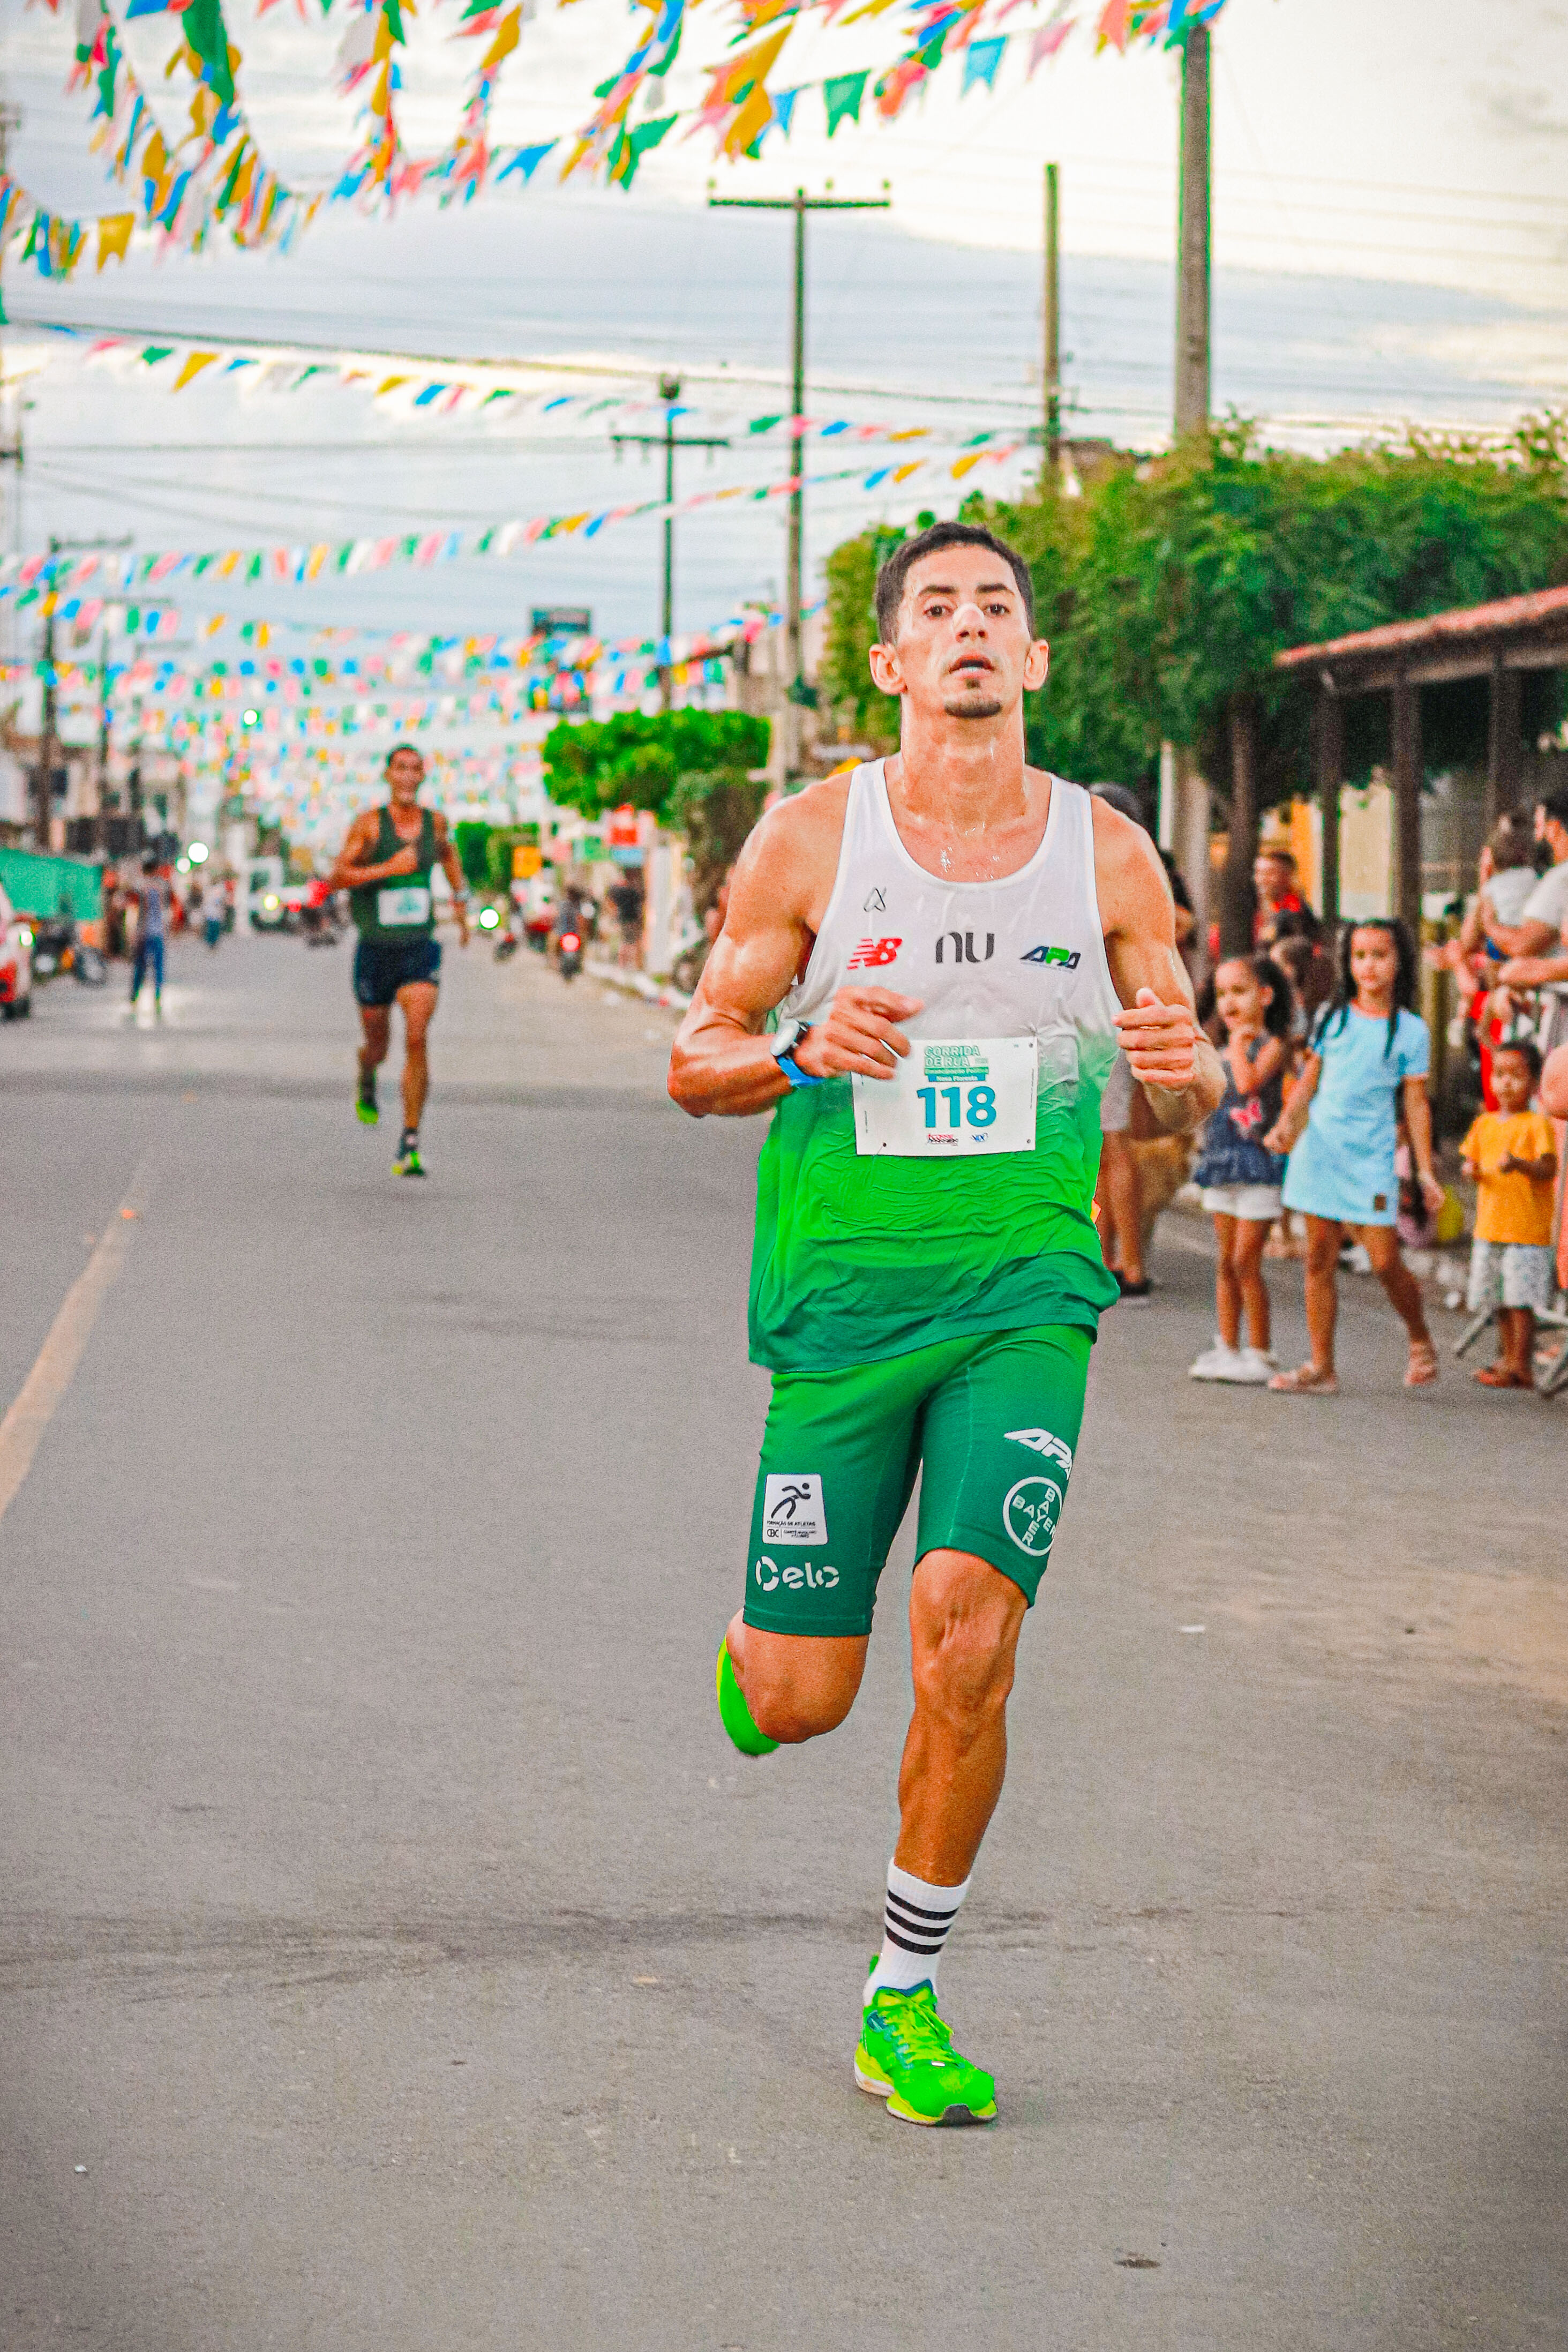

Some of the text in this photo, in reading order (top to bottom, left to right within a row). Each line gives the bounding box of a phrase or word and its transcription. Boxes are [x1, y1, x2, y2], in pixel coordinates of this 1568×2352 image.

[925, 1046, 980, 1057] CORRIDA
[925, 1056, 941, 1067] DE
[944, 1056, 970, 1067] RUA
[917, 1086, 996, 1128] 118
[1021, 1487, 1056, 1547] BAYER
